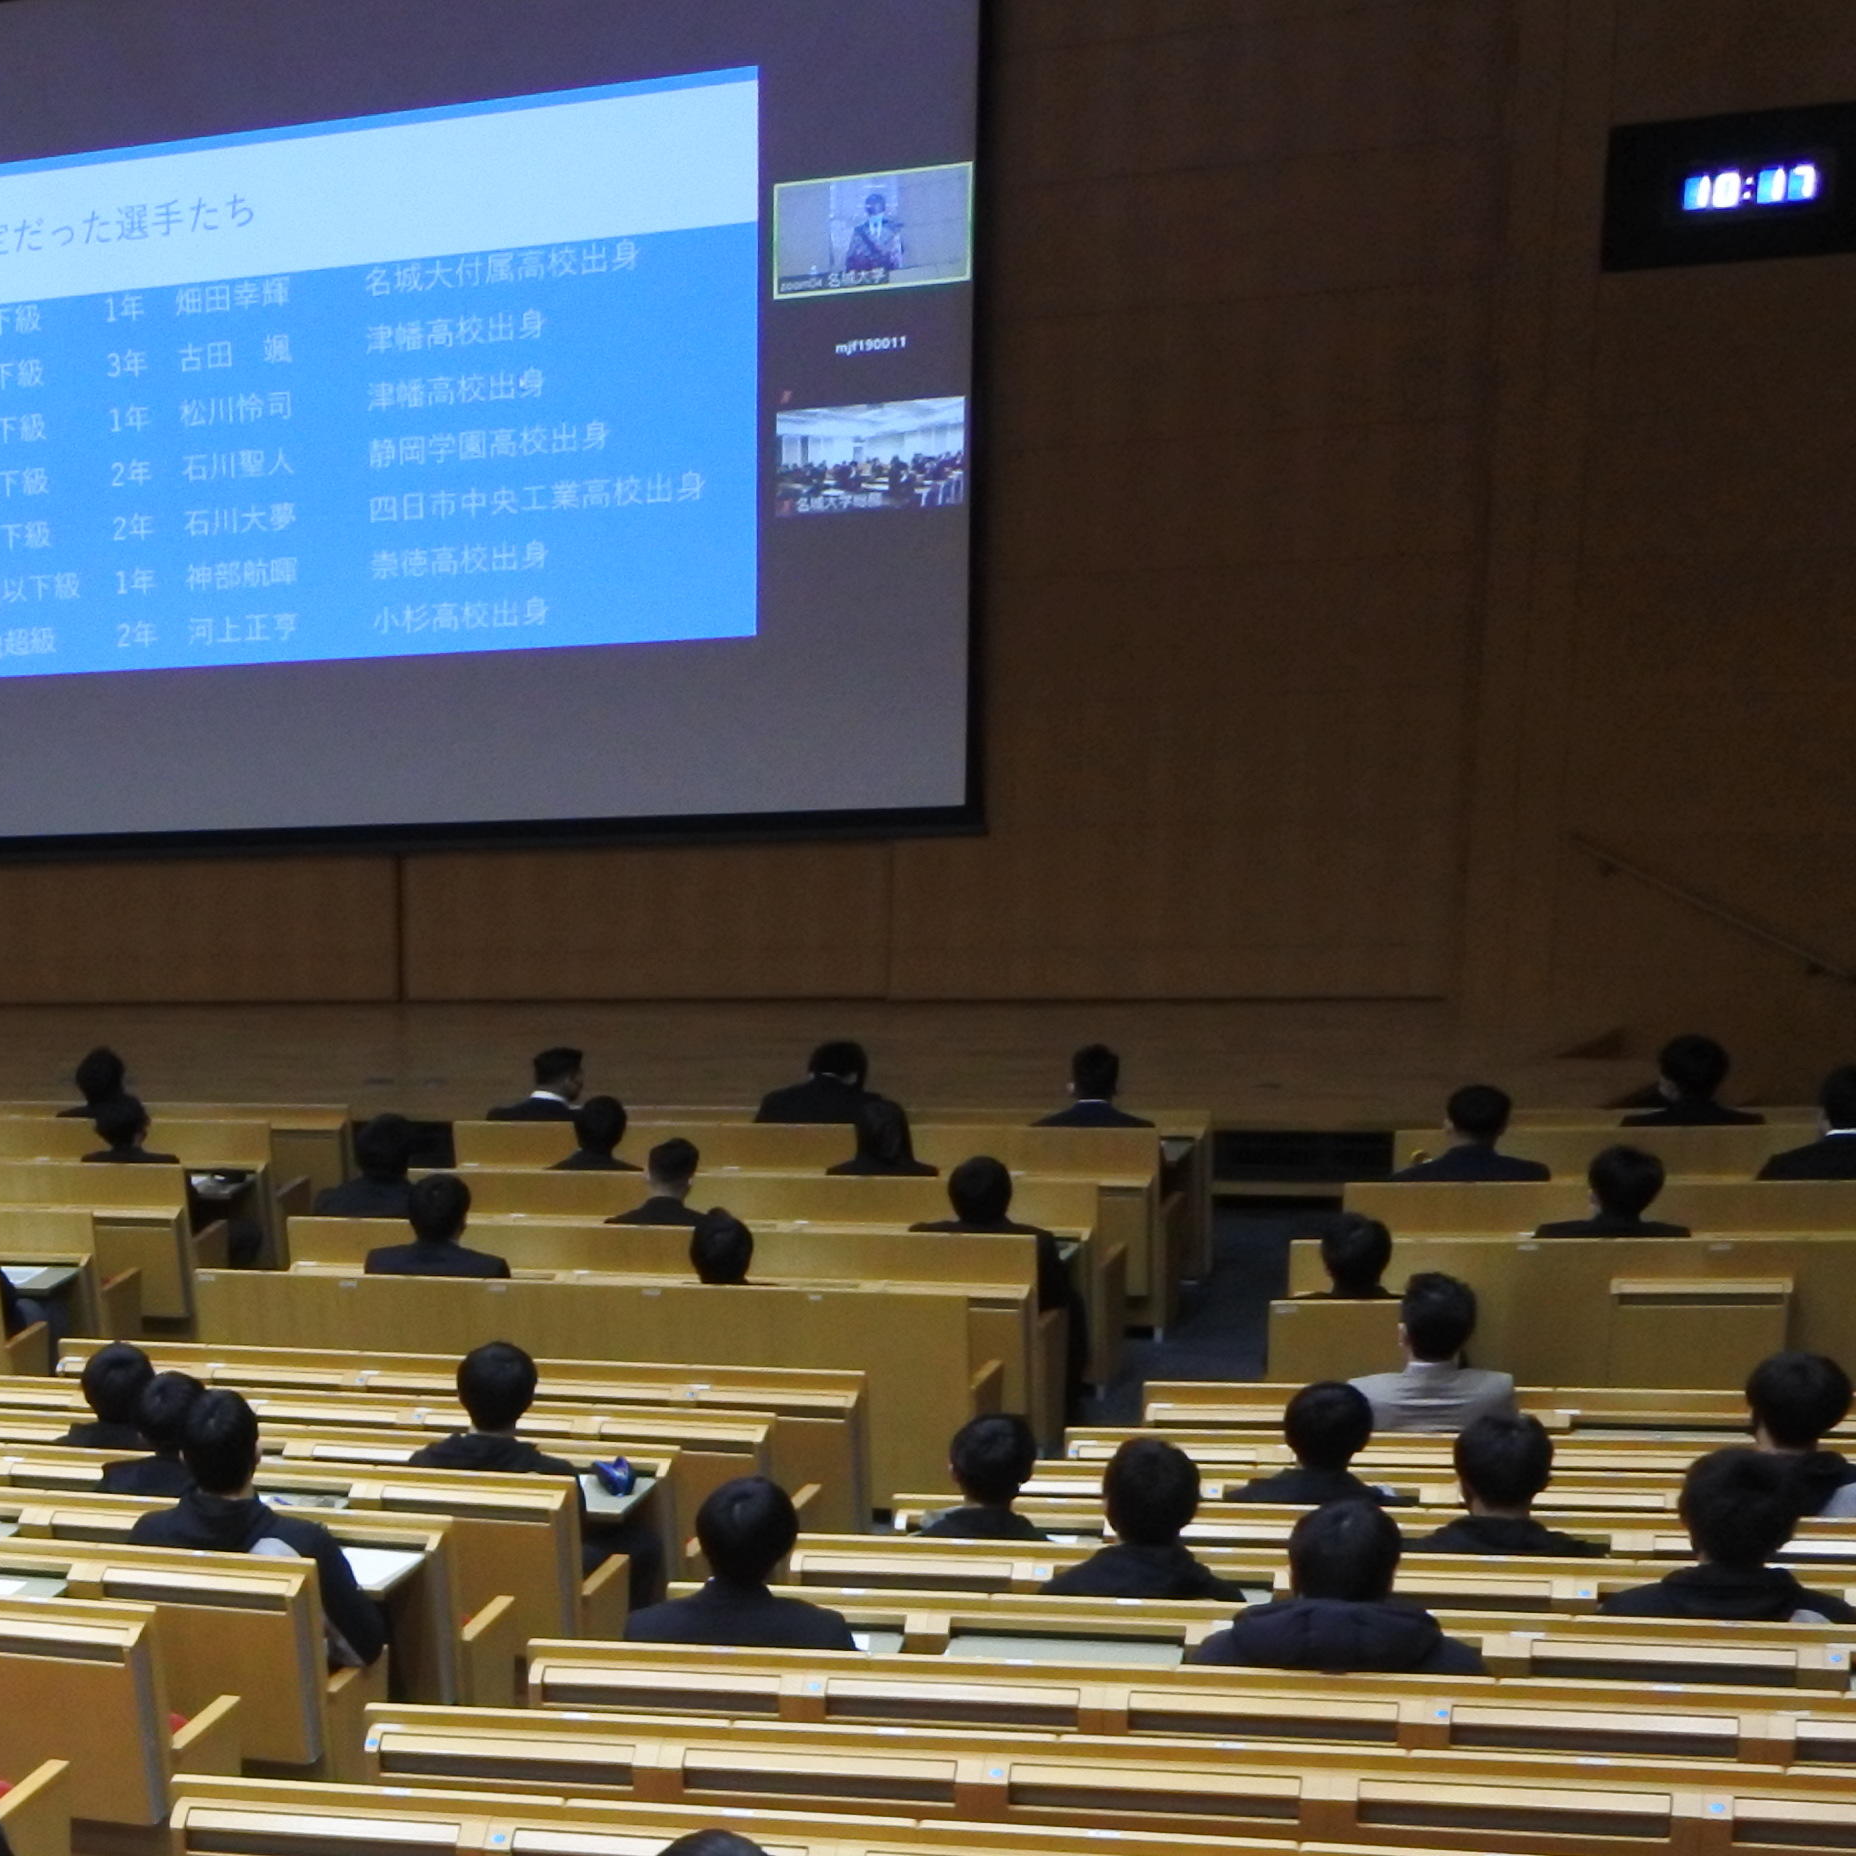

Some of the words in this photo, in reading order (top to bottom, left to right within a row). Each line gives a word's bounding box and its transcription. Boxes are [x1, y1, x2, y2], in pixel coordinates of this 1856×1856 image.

[106, 295, 145, 323] 1年
[364, 238, 640, 298] 名城大付属高校出身
[106, 351, 148, 379] 3年
[179, 341, 233, 373] 古田
[365, 308, 547, 355] 津幡高校出身
[835, 336, 907, 355] mjf190011
[109, 405, 151, 434] 1年
[111, 459, 152, 488] 2年
[112, 512, 155, 542] 2年
[369, 470, 707, 524] 四日市中央工業高校出身
[115, 568, 157, 596] 1年
[117, 622, 159, 649] 2年
[372, 596, 550, 635] 小杉高校出身
